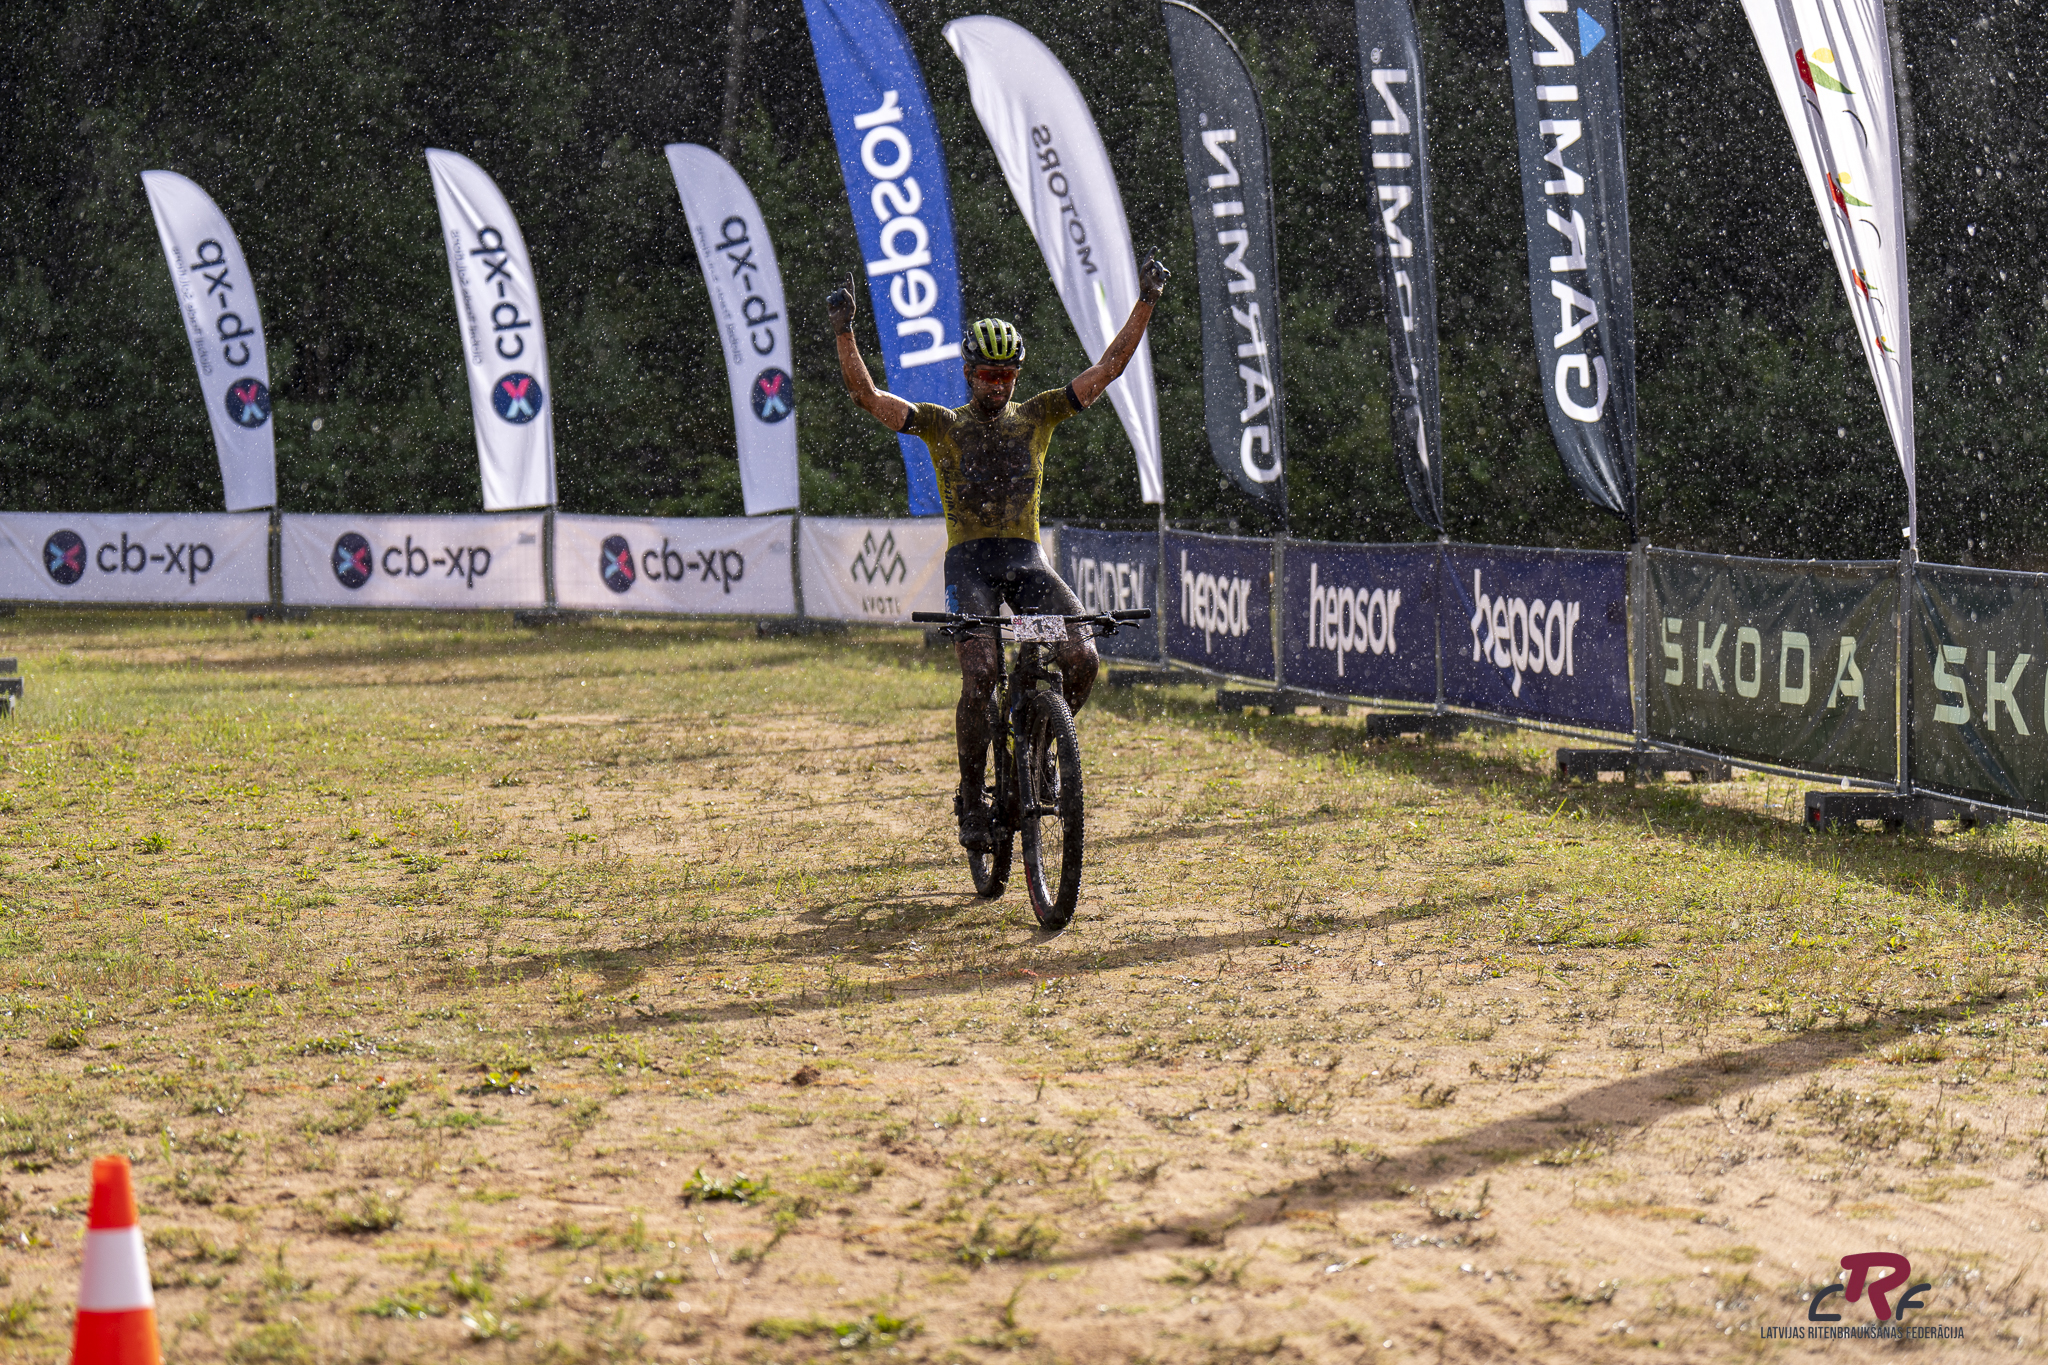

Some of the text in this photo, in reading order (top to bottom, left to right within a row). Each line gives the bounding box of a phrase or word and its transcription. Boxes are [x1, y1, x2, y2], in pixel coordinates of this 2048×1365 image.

[96, 532, 214, 584] cb-xp
[381, 536, 491, 588] cb-xp
[642, 538, 744, 594] cb-xp
[1180, 549, 1251, 654] hepsor
[1308, 563, 1400, 676] hepsor
[1470, 568, 1579, 697] hepsor
[1933, 645, 2048, 736] SK
